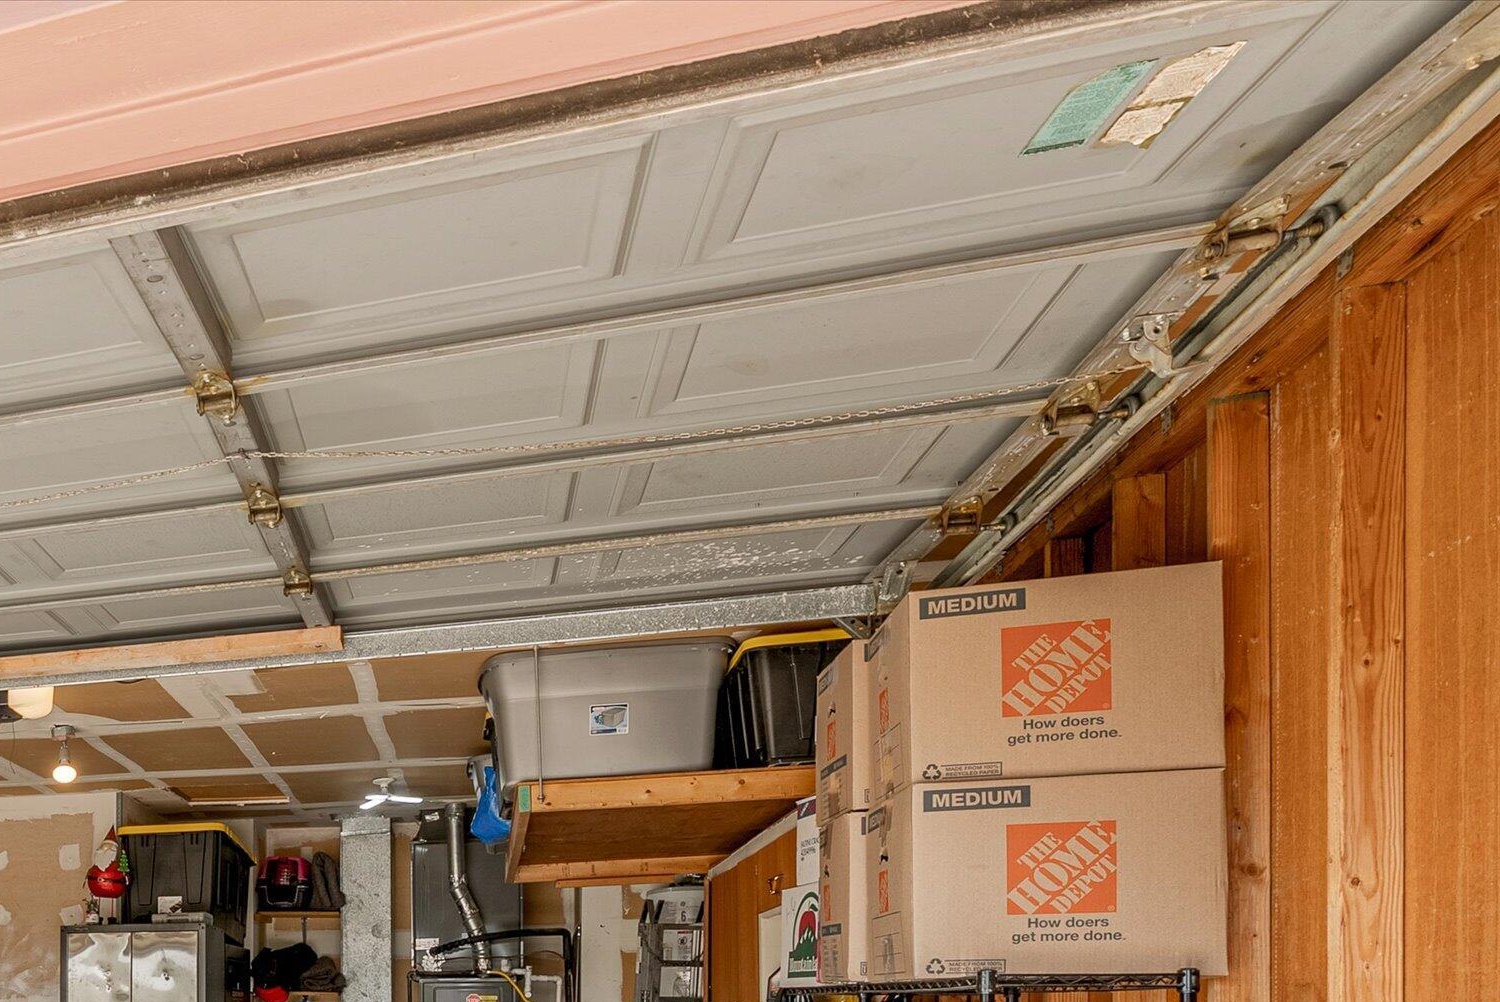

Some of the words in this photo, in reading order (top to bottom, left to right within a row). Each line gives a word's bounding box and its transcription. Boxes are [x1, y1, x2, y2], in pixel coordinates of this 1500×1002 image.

[928, 593, 1017, 615] MEDIUM
[1012, 633, 1058, 671] THE
[1002, 620, 1111, 716] HOME
[1045, 652, 1111, 714] DEPOT
[1007, 733, 1031, 746] get
[1036, 730, 1075, 742] more
[1080, 727, 1122, 740] done.
[1023, 718, 1056, 730] How
[1061, 715, 1105, 727] doers
[932, 790, 1022, 808] MEDIUM
[1017, 831, 1063, 870] THE
[1007, 820, 1116, 914] HOME
[1050, 854, 1117, 914] DEPOT
[1027, 917, 1061, 928] How
[1065, 916, 1109, 928] doers
[1011, 931, 1036, 945] get
[1040, 931, 1079, 942] more
[1083, 930, 1126, 941] done.
